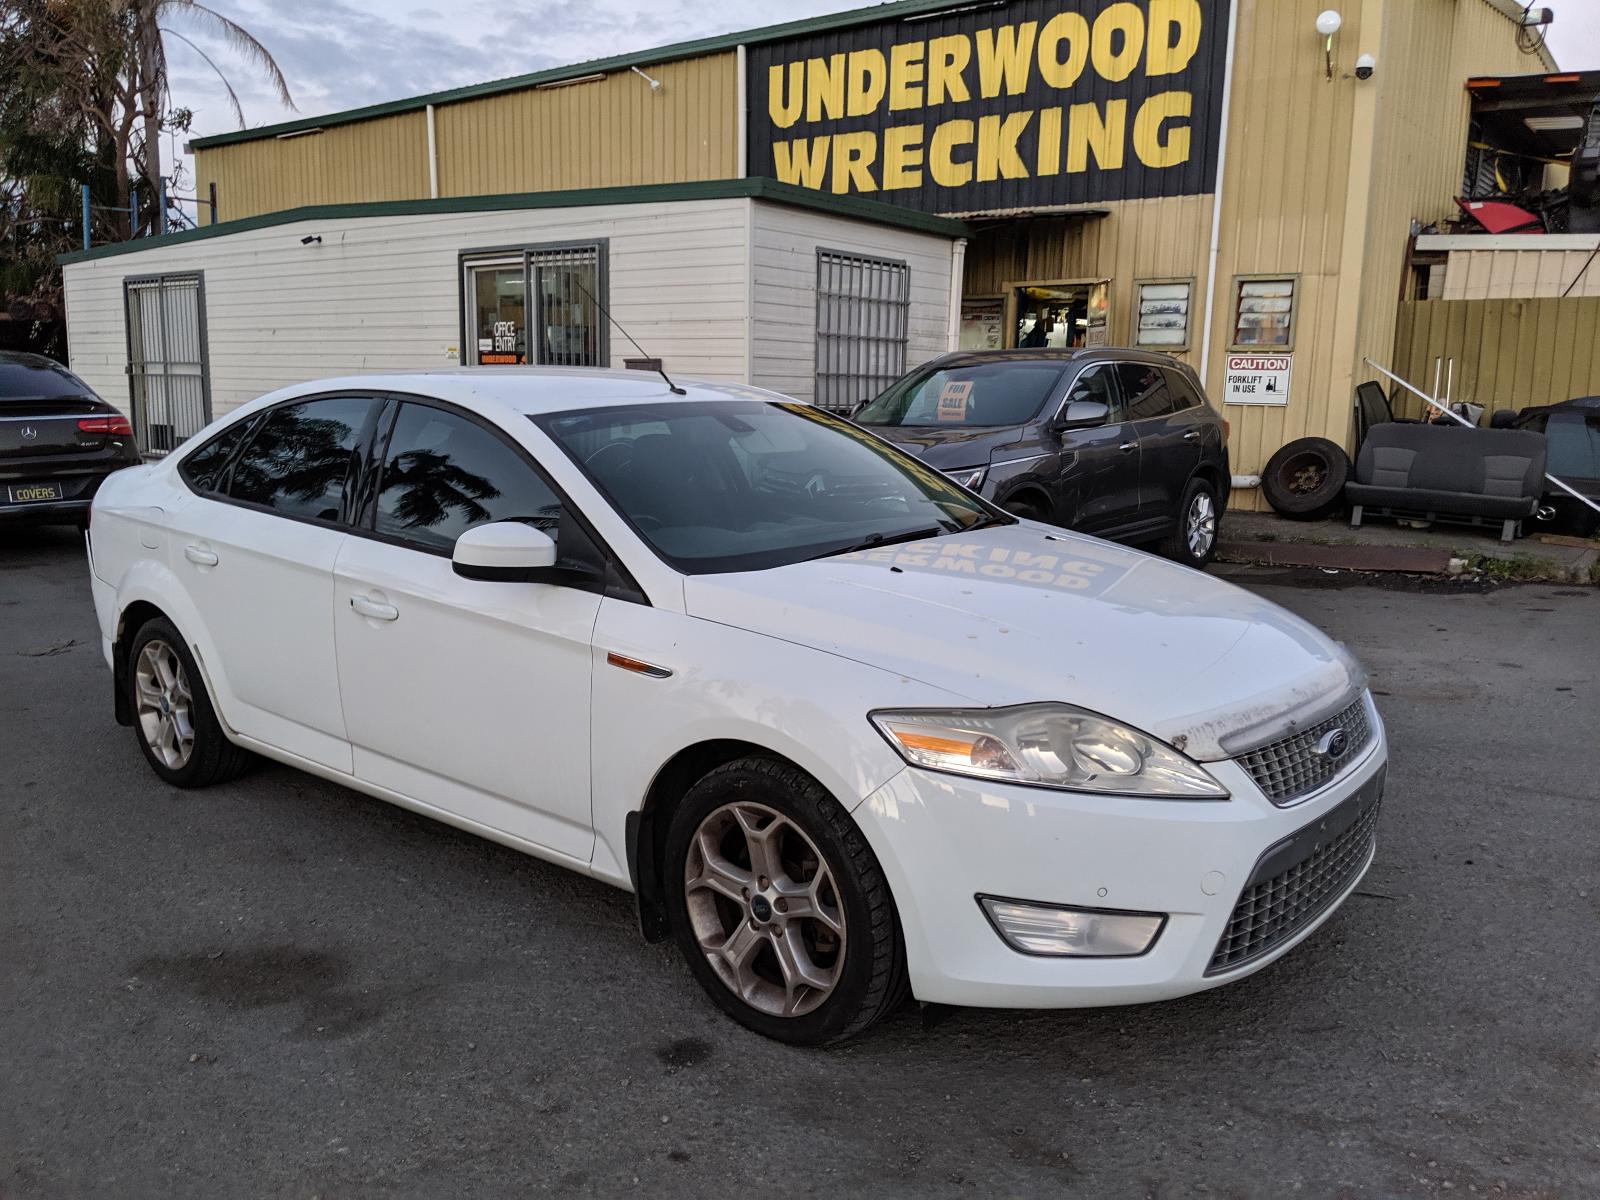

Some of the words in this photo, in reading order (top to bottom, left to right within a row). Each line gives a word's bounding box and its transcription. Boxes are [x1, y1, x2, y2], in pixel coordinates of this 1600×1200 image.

[769, 0, 1201, 128] UNDERWOOD
[773, 91, 1192, 194] WRECKING
[494, 322, 515, 336] OFFICE
[495, 337, 516, 351] ENTRY
[481, 355, 516, 363] UNDERWOOD
[1231, 359, 1287, 369] CAUTION
[1228, 375, 1263, 384] FORKLIFT
[948, 384, 967, 393] FOR
[1232, 385, 1240, 393] IN
[1242, 385, 1256, 393] USE
[942, 397, 964, 409] SALE
[16, 488, 55, 500] COVERS
